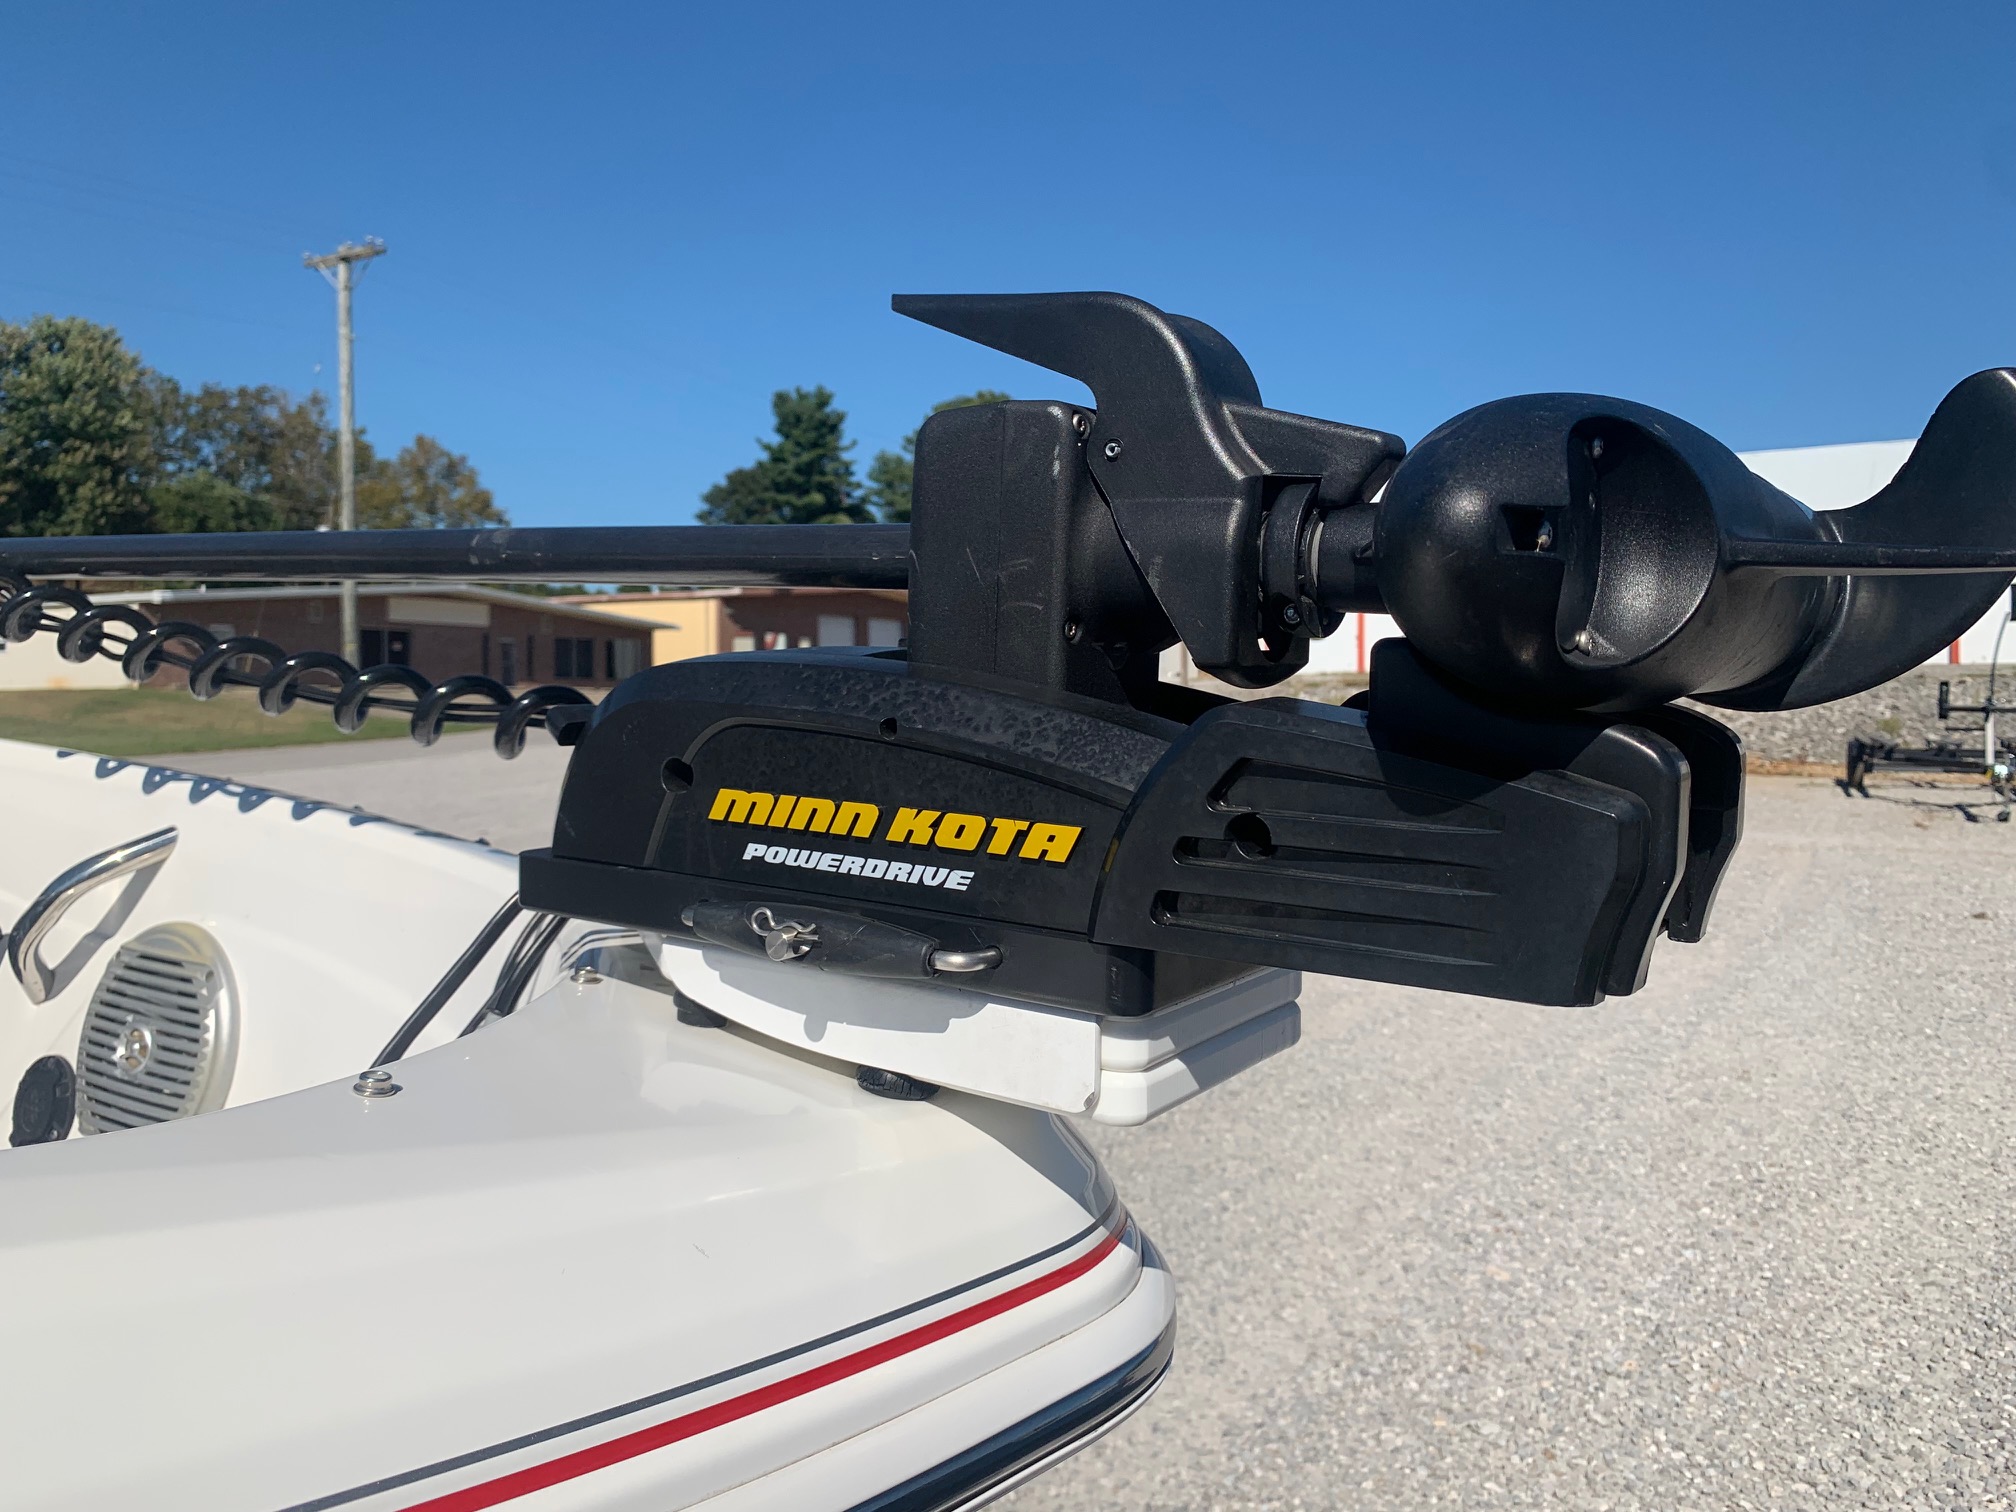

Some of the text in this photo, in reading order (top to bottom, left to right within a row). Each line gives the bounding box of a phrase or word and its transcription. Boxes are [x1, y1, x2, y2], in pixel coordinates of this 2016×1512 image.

[708, 788, 1082, 863] MINN KOTA
[742, 842, 975, 891] POWERDRIVE
